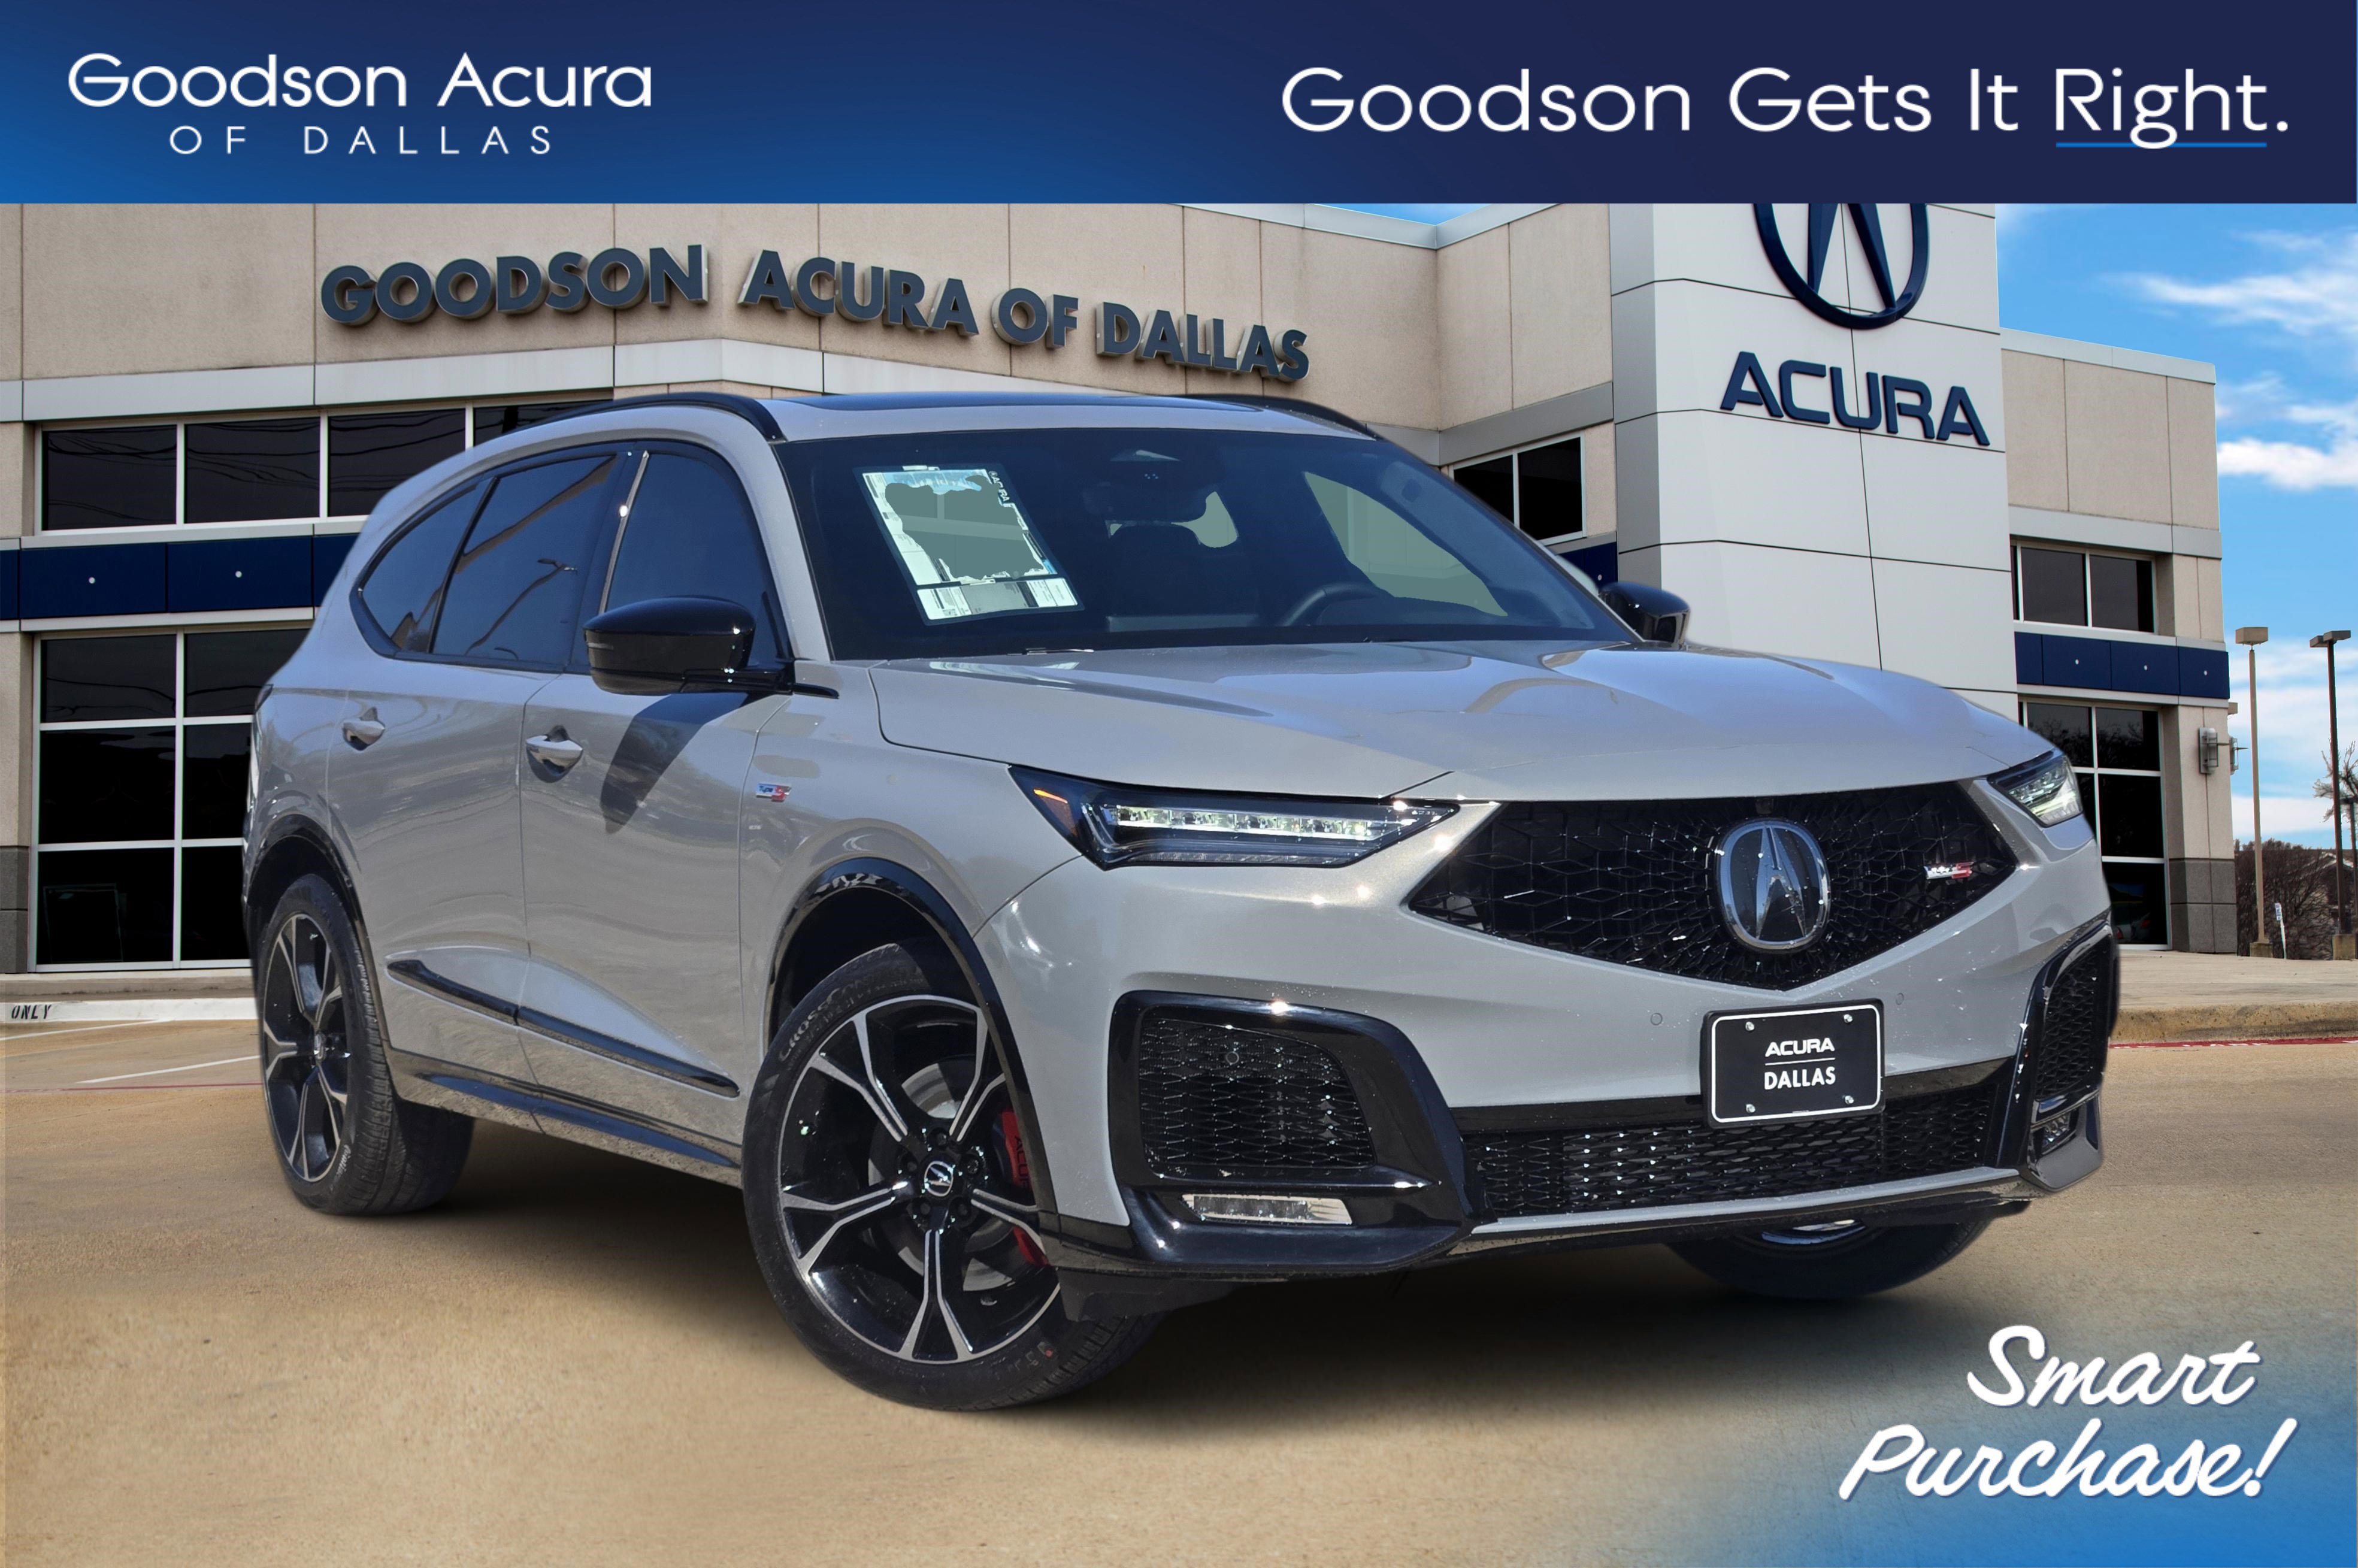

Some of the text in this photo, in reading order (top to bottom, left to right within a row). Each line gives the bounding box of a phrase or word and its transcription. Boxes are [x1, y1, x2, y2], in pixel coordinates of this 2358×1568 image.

[321, 244, 1310, 382] GOODSON ACURA OF DALLAS
[1720, 351, 1990, 446] ACURA
[11, 1004, 52, 1019] ONLY
[1764, 1037, 1835, 1057] ACURA
[1764, 1066, 1836, 1090] DALLAS
